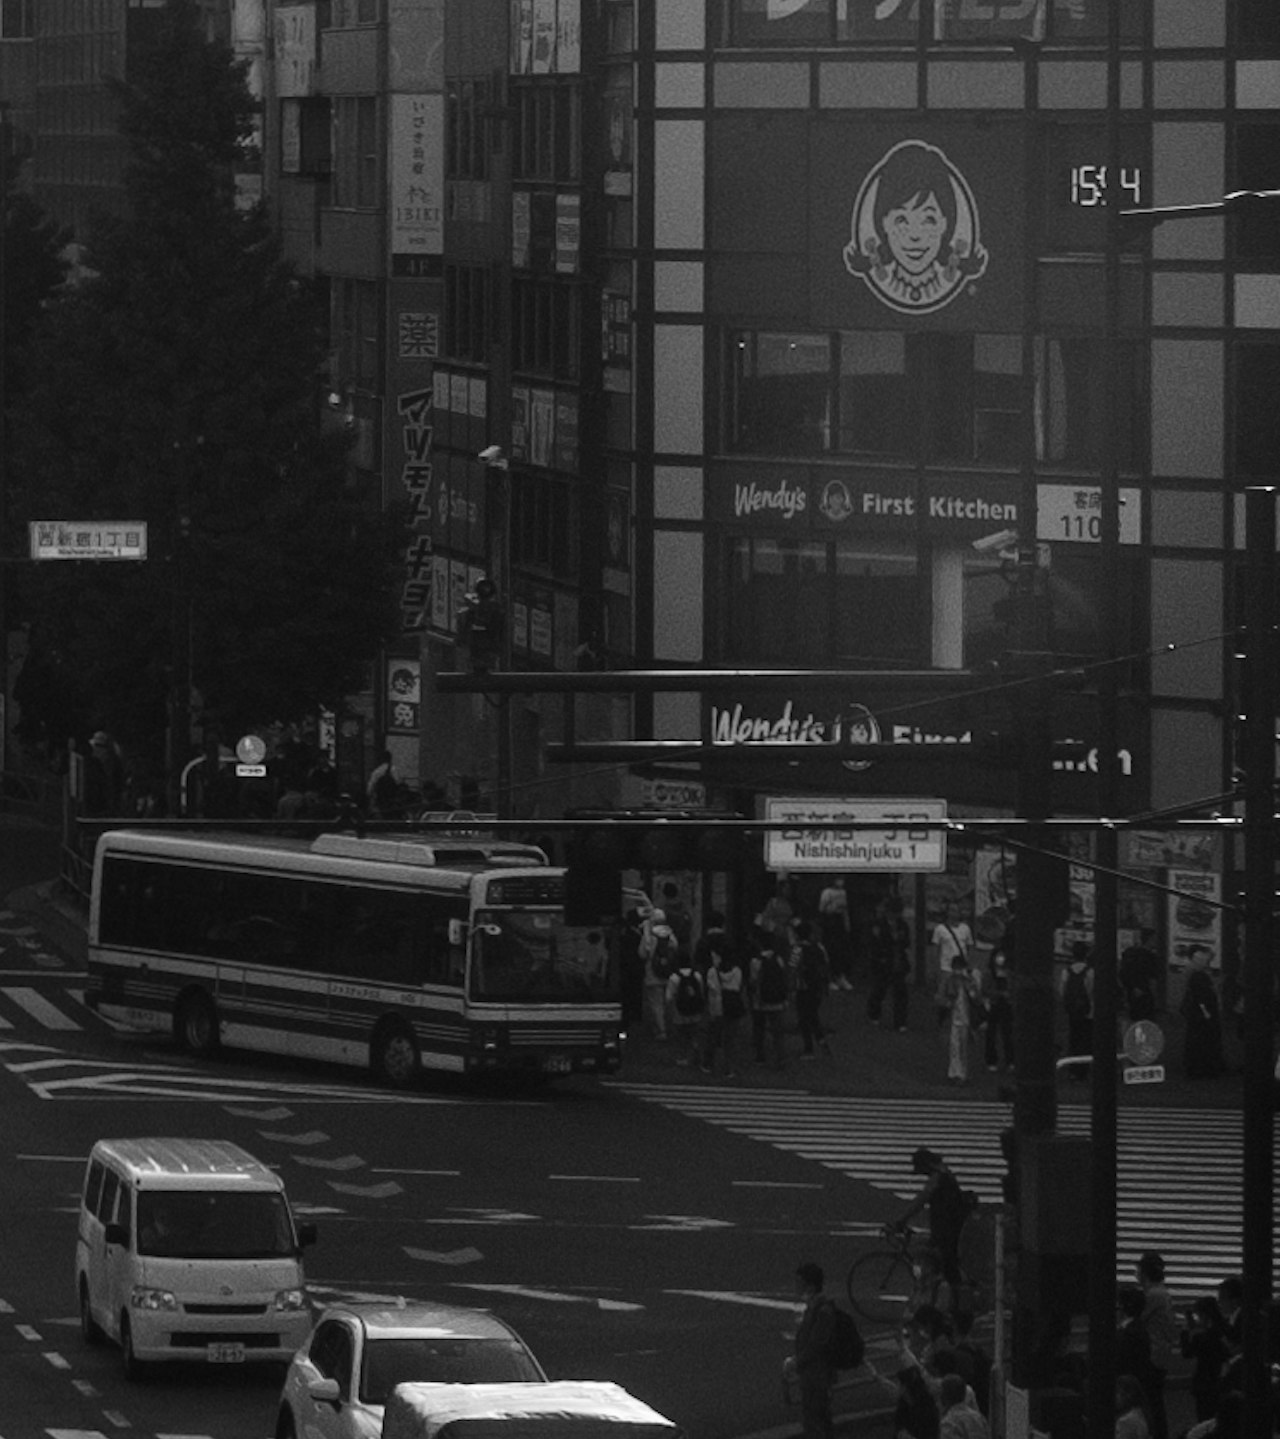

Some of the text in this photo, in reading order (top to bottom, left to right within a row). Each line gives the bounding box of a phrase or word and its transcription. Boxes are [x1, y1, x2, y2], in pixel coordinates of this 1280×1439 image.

[734, 480, 1019, 521] Wendy's First Kitchen
[793, 842, 918, 863] Nishishinjuku 1
